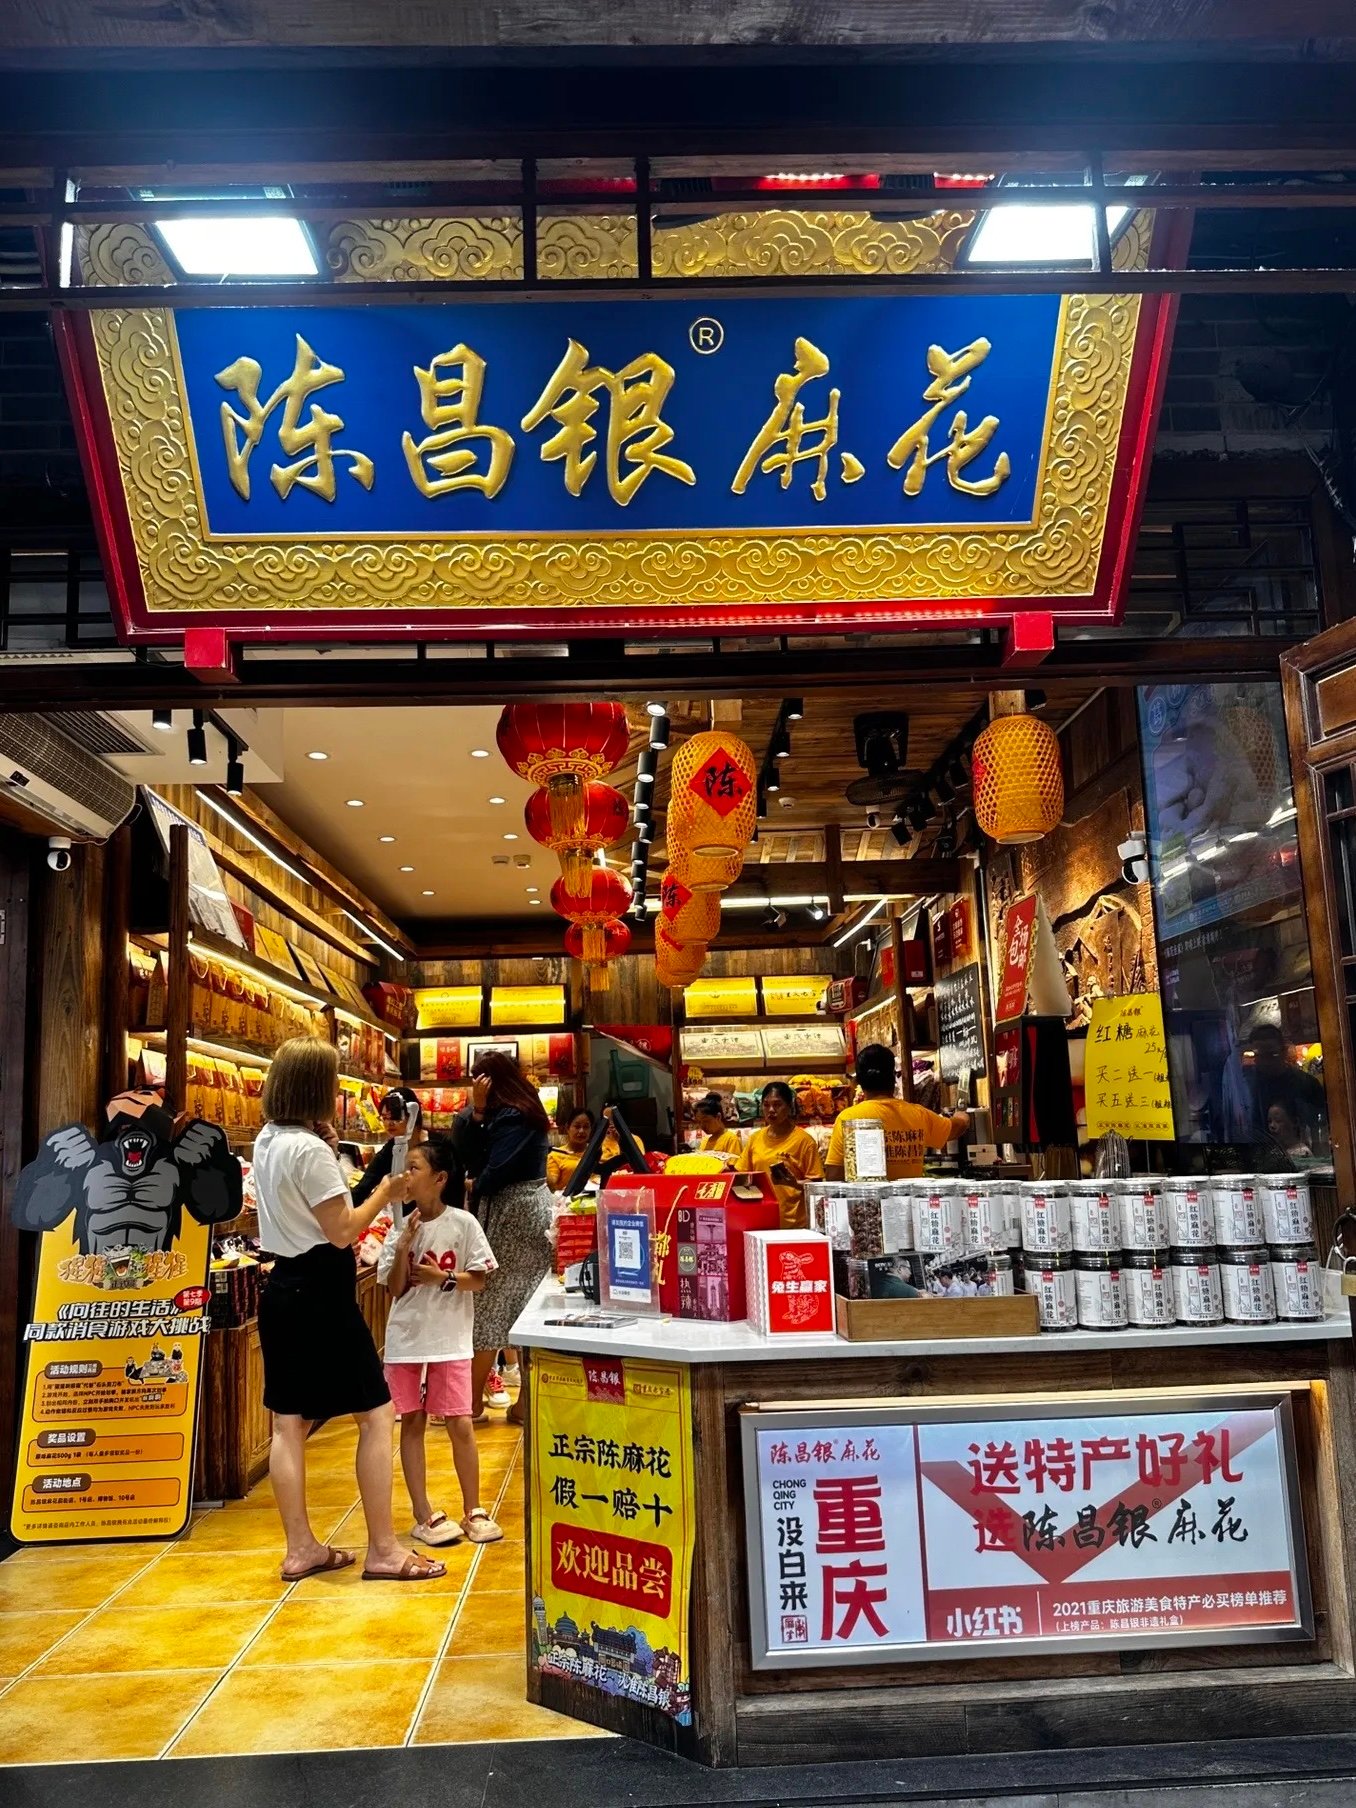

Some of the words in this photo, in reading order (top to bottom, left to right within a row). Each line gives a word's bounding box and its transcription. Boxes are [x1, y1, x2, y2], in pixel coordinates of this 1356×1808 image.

[704, 761, 743, 798] 陈
[23, 1317, 211, 1342] 同款消食游戏大挑战
[47, 1432, 86, 1444] 奖品设置
[548, 1433, 672, 1480] 正宗陈麻花
[966, 1428, 1244, 1497] 送特产好礼
[42, 1477, 82, 1489] 活动地点
[772, 1479, 807, 1489] CHONG
[773, 1490, 796, 1500] QING
[550, 1475, 673, 1528] 假一赔十
[773, 1501, 795, 1511] CITY
[555, 1538, 668, 1599] 欢迎品尝
[777, 1516, 808, 1611] 没白来
[813, 1475, 890, 1641] 重庆
[1052, 1589, 1287, 1617] 2021重庆旅游美食特产必买榜单推荐
[947, 1604, 1024, 1638] 小红书
